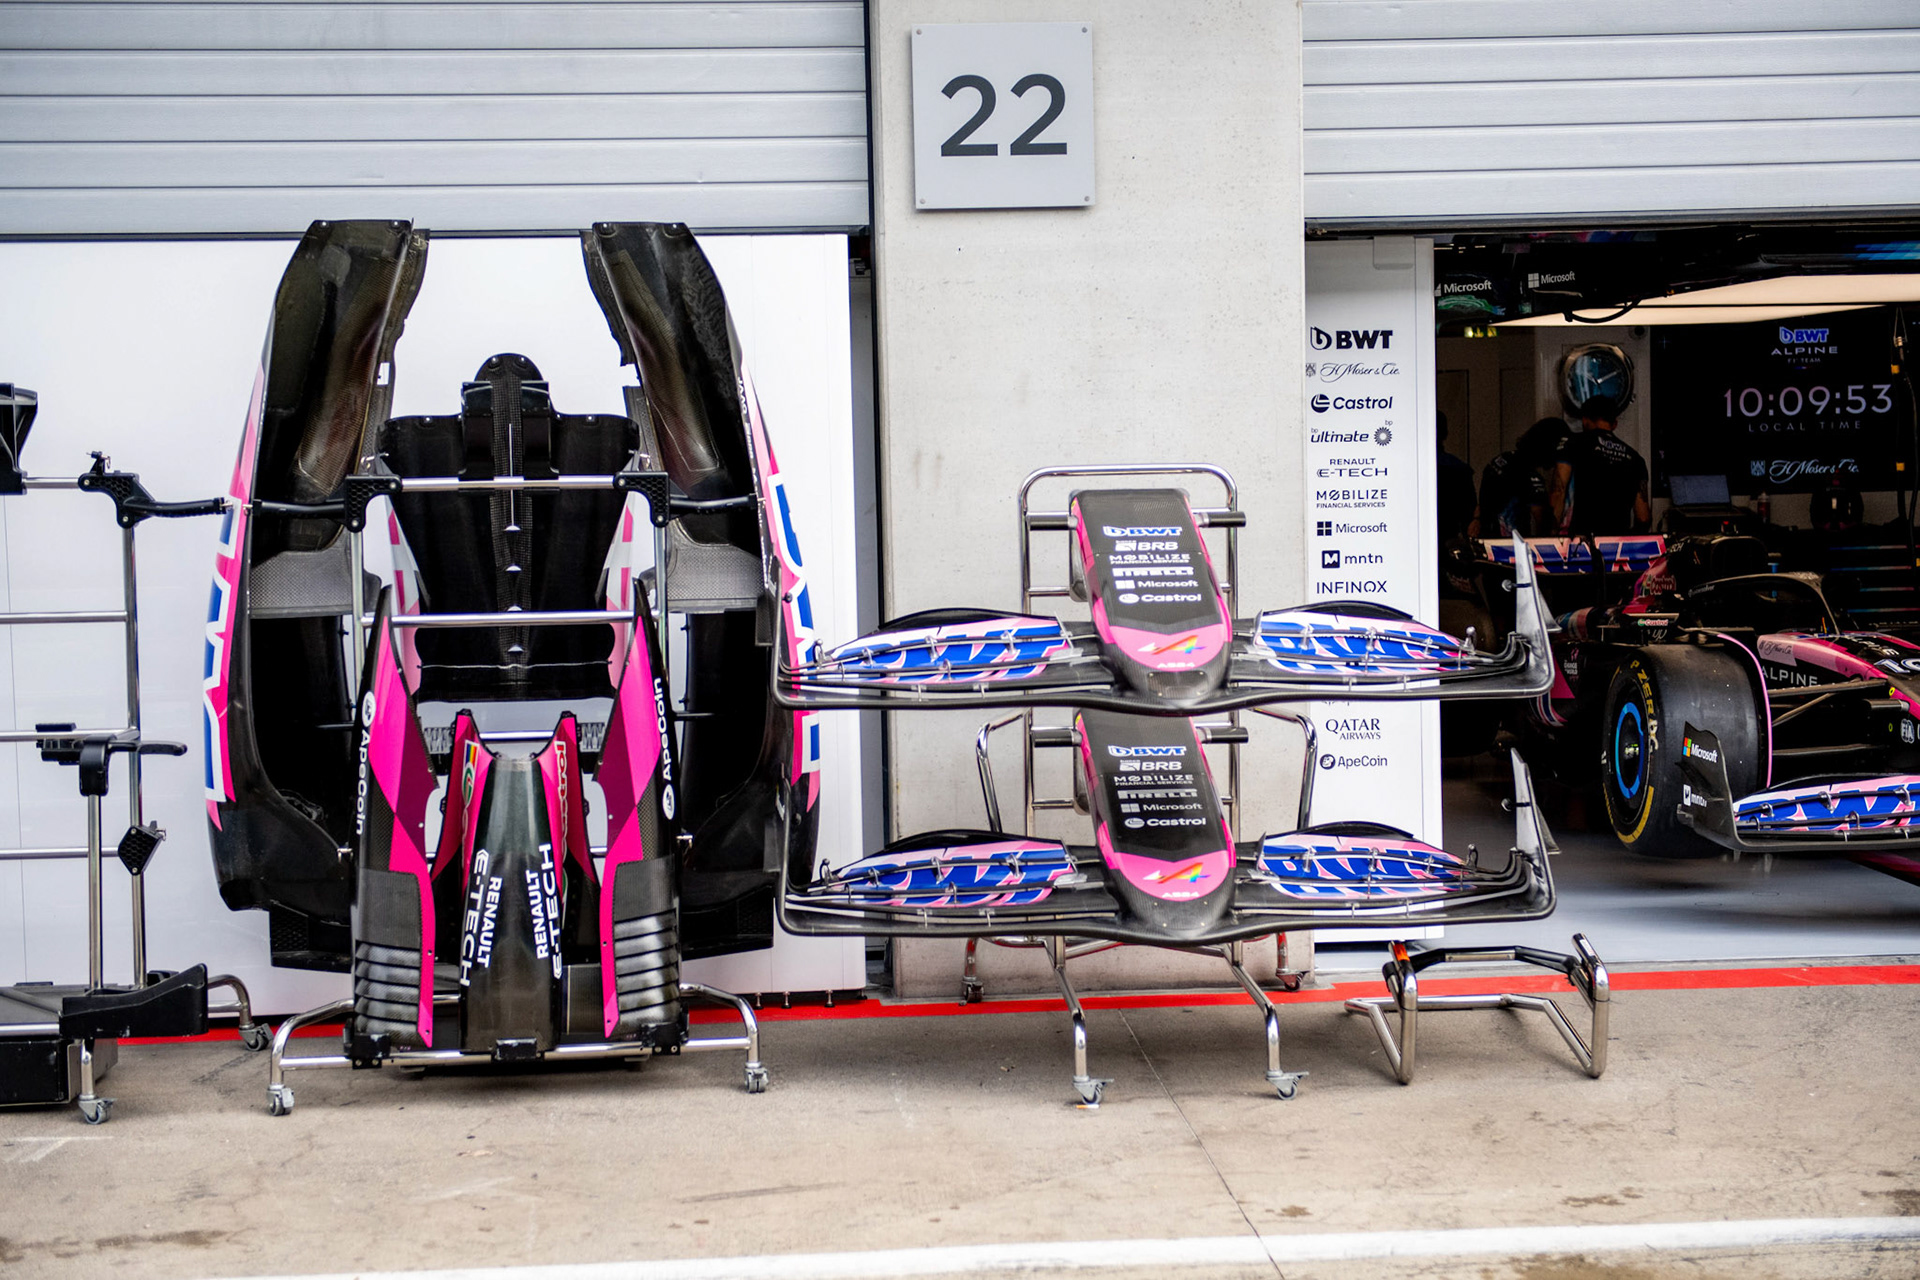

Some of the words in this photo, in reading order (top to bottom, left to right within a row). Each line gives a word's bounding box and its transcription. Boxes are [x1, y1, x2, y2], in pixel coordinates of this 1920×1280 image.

[941, 73, 1067, 157] 22
[1541, 270, 1576, 285] Microsoft
[1444, 279, 1492, 294] Microsoft
[1336, 330, 1393, 349] BWT
[1794, 328, 1829, 344] BWT
[1771, 346, 1838, 356] ALPINE
[1333, 396, 1393, 410] Castrol
[1724, 384, 1893, 418] 10:09:53
[1748, 422, 1806, 433] LOCAL
[1819, 420, 1861, 430] TIME
[1310, 430, 1369, 443] ultimate
[1317, 467, 1388, 478] E-TECH
[1128, 526, 1182, 536] BWT
[1336, 522, 1387, 533] Microsoft
[1138, 541, 1179, 551] BRB
[1344, 553, 1383, 564] mntn
[1137, 580, 1199, 588] Microsoft
[1317, 580, 1387, 594] INFINOX
[1141, 593, 1202, 602] Castrol
[1762, 665, 1819, 687] ALPINE
[653, 677, 674, 781] ApeCoin
[1325, 718, 1380, 734] QATAR
[1340, 732, 1381, 740] AIRWAYS
[1133, 746, 1187, 756] BWT
[1691, 743, 1718, 763] Microsoft
[1141, 761, 1182, 771] BRB
[1338, 756, 1388, 769] ApeCoin
[356, 730, 370, 836] ApeCoin
[1117, 789, 1198, 799] PIRELLI
[1143, 802, 1203, 811] Microsoft
[1147, 818, 1206, 827] Castrol
[459, 849, 489, 987] E-TECH
[526, 869, 549, 960] RENAULT
[538, 843, 563, 980] E-TECH
[477, 876, 503, 969] RENAULT
